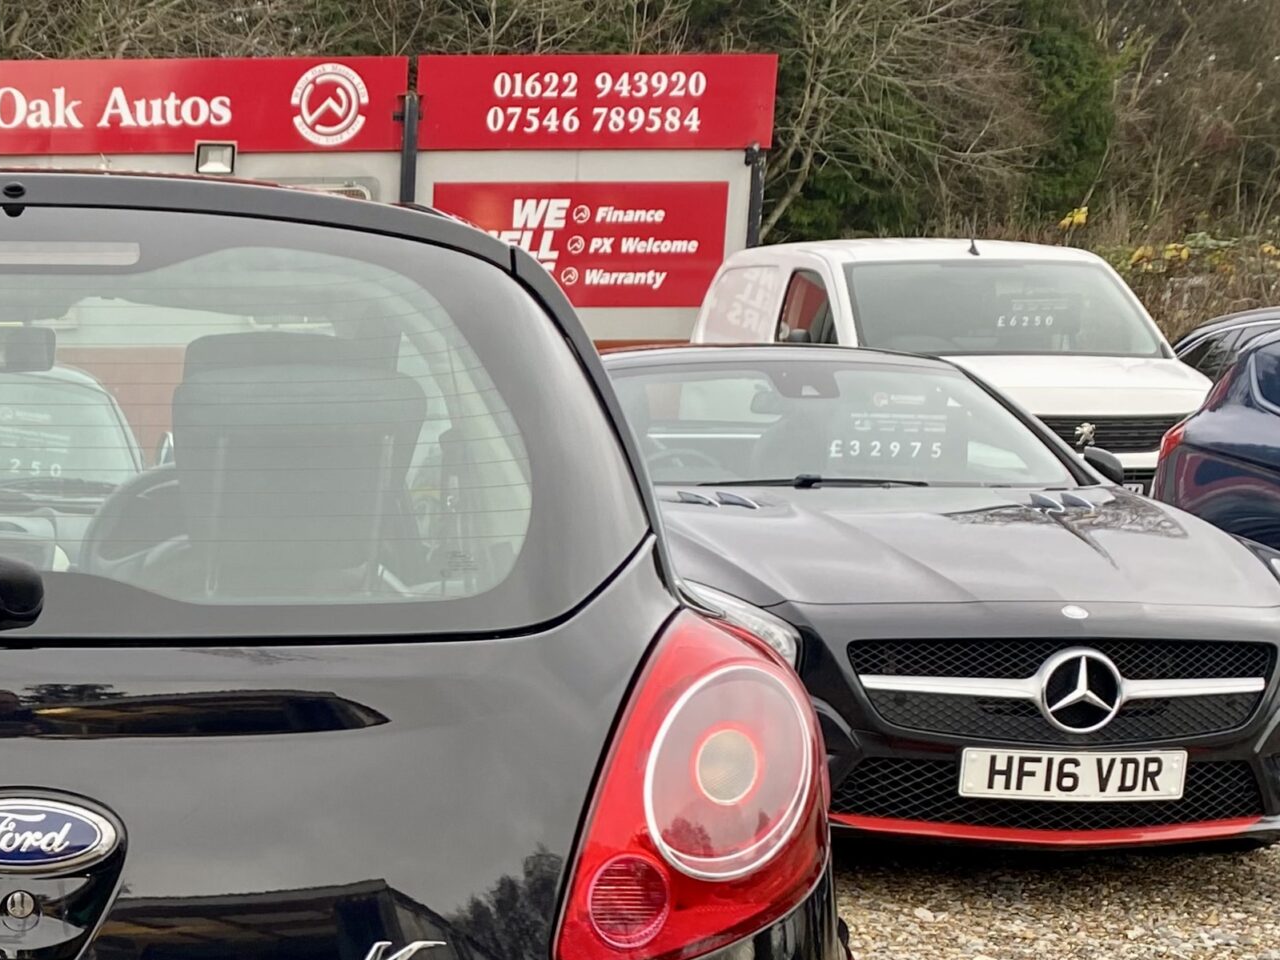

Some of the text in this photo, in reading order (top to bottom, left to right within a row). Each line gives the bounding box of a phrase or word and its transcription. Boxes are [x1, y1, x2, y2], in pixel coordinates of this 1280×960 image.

[493, 71, 707, 99] 01622 943920
[96, 85, 233, 129] Autos
[485, 106, 702, 133] 07546 789584
[512, 198, 572, 230] WE
[594, 206, 666, 224] Finance
[588, 236, 699, 255] PX Welcome
[584, 268, 667, 290] Warranty
[829, 439, 942, 459] £32975
[986, 754, 1163, 793] HF16 VDR
